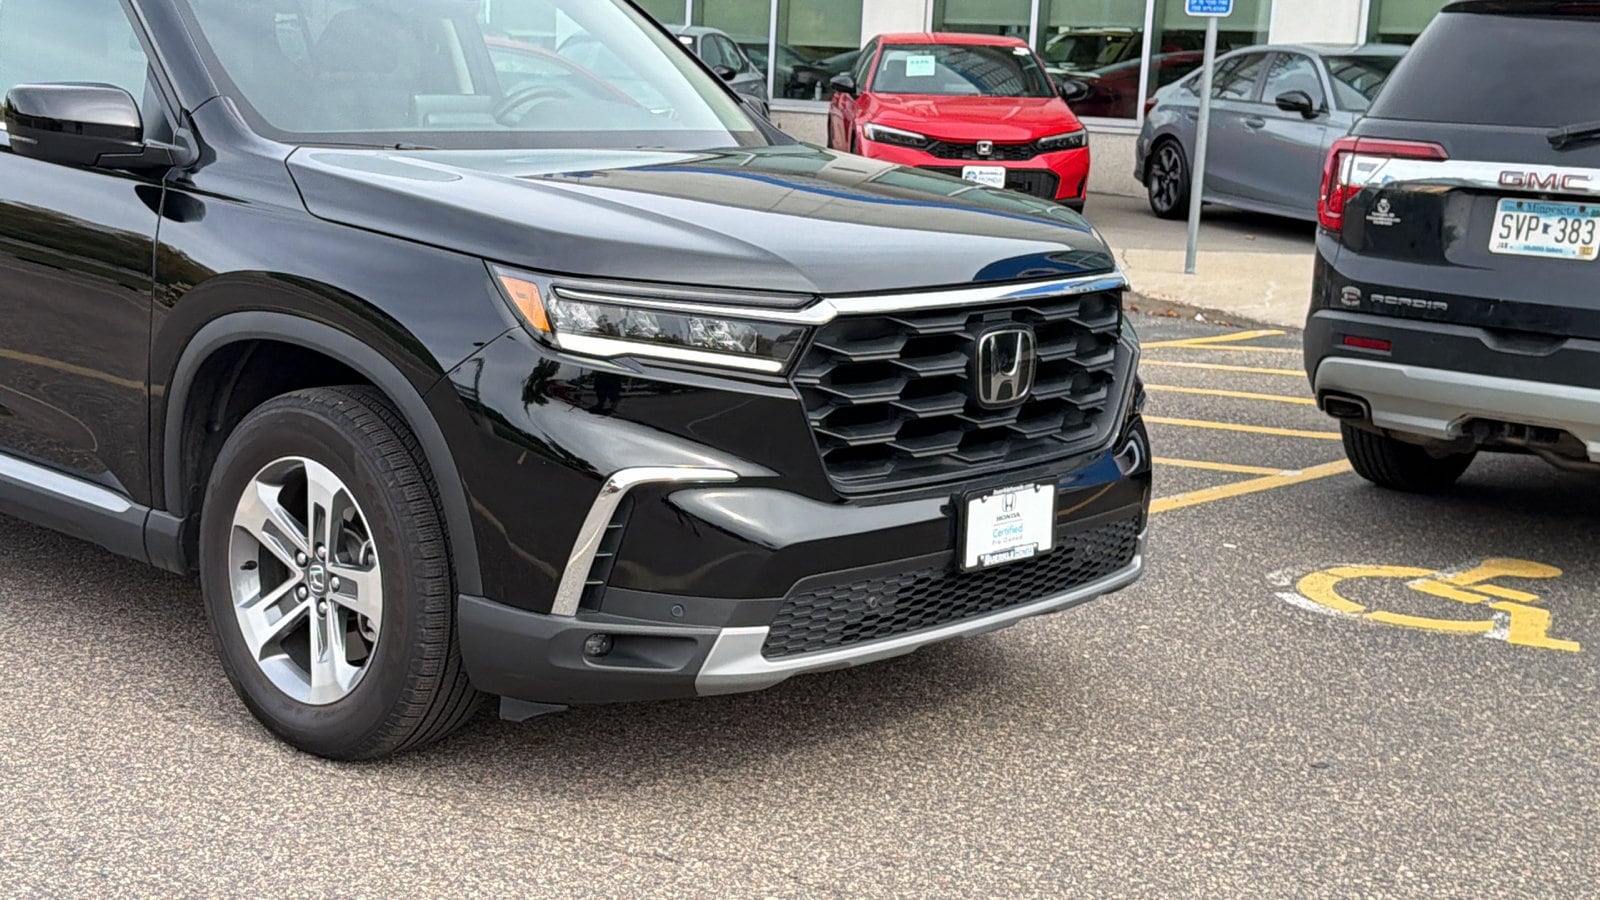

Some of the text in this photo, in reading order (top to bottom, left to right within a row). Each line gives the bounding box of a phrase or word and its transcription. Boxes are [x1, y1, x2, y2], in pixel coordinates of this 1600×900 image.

[1499, 171, 1591, 191] GMC
[1526, 202, 1575, 217] Minnesota
[1499, 213, 1596, 245] SVP 383
[1370, 293, 1448, 311] ACADIA
[996, 512, 1021, 522] HONDA
[992, 524, 1024, 538] Certified
